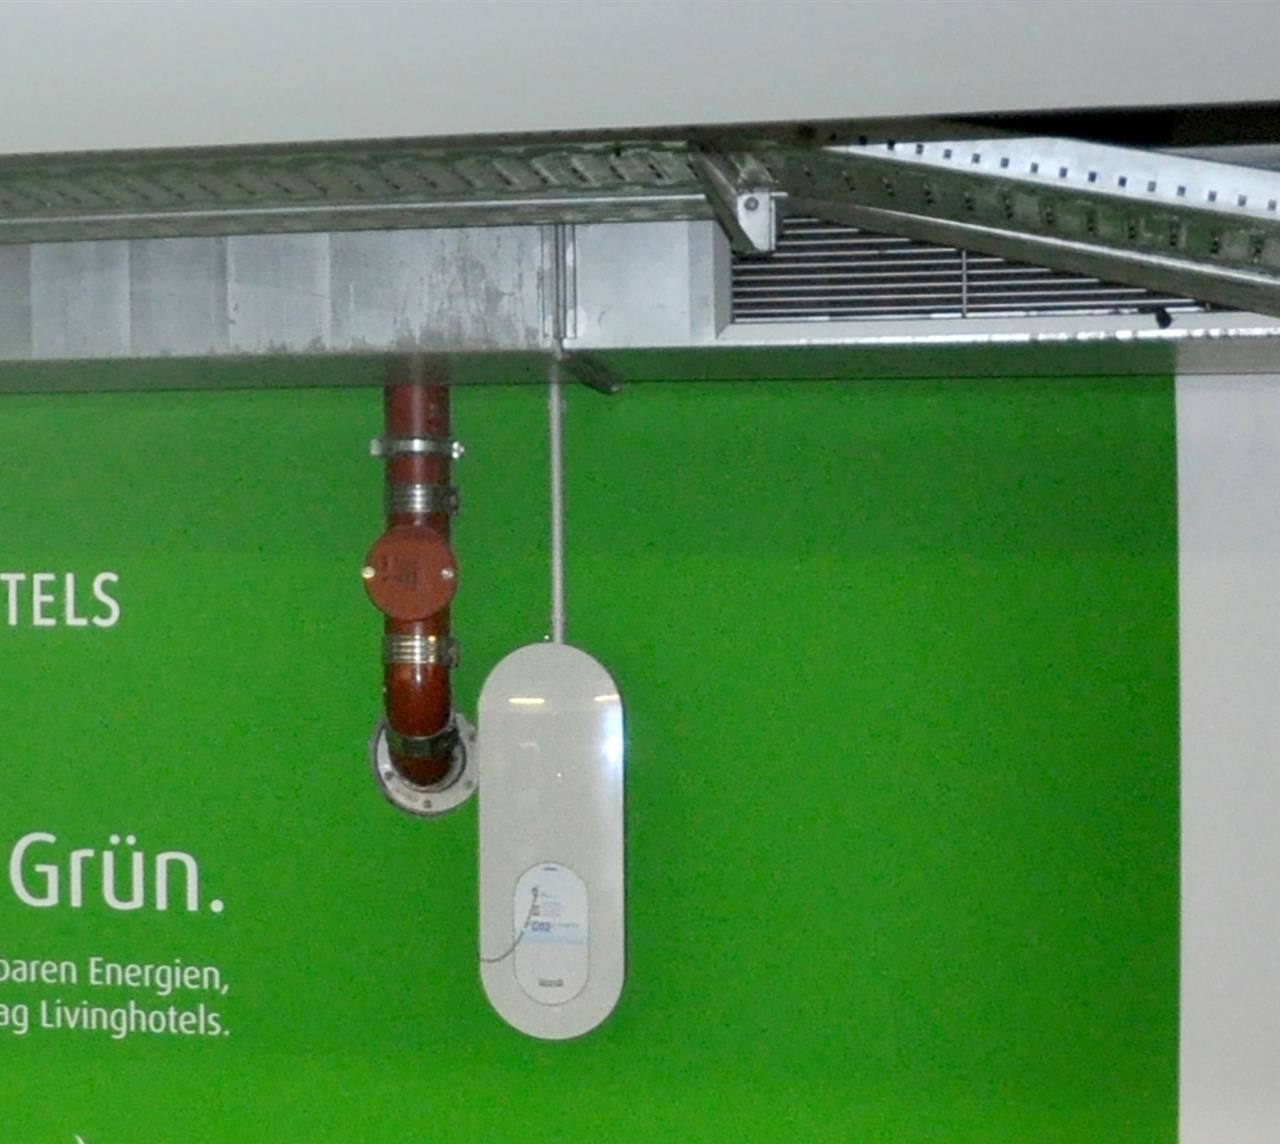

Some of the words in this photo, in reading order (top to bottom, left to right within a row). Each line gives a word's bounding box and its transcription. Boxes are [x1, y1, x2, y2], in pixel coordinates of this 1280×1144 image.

[9, 831, 224, 913] Grün.
[89, 956, 229, 997] Energien,
[40, 999, 230, 1040] Livinghotels.
